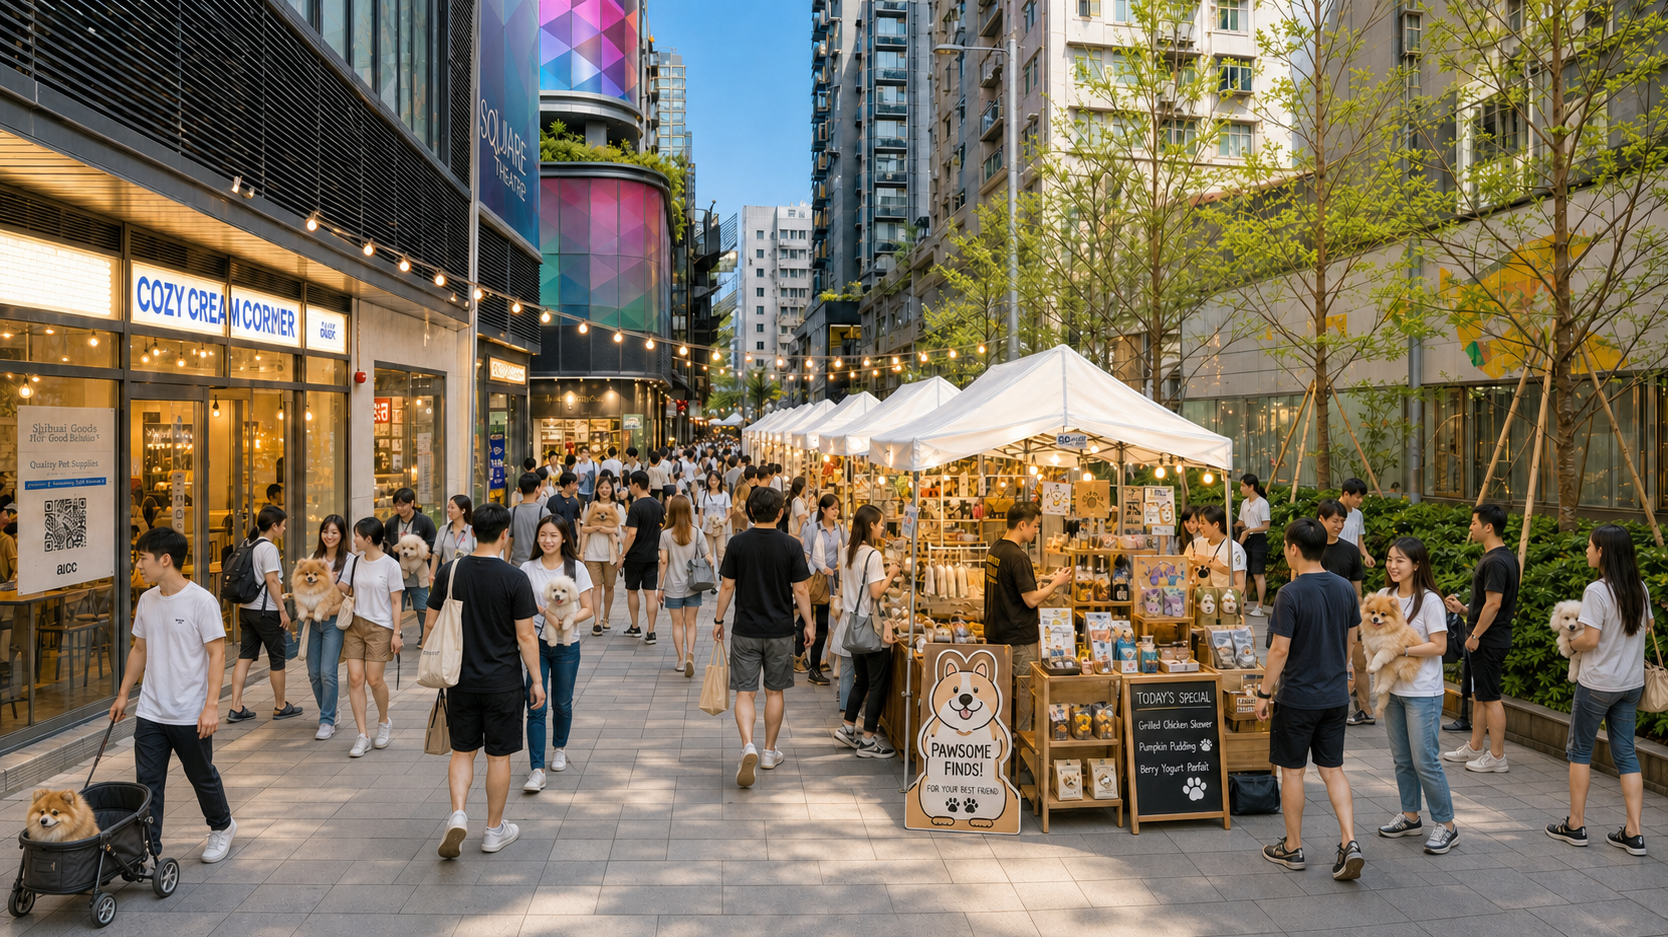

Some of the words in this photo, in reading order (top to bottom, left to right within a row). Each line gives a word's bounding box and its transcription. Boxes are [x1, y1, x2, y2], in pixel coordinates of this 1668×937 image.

[480, 98, 527, 176] SQUARE
[494, 155, 526, 202] THEATRE
[137, 276, 185, 317] COZY
[188, 287, 240, 328] CREAM
[71, 424, 98, 433] Goods
[48, 434, 68, 442] Good
[1136, 692, 1175, 704] TODAY'S
[1179, 691, 1211, 704] SPECIAL
[1138, 720, 1161, 730] Grilled
[931, 742, 992, 759] PAWSOME
[1139, 742, 1167, 754] Pumpkin
[1170, 741, 1196, 753] Pudding
[944, 761, 983, 777] FINDS!
[1140, 765, 1159, 776] Berry
[1161, 764, 1184, 776] Yogurt
[1187, 762, 1210, 772] Parfait
[927, 784, 939, 793] FOR
[960, 786, 975, 794] BEST
[977, 787, 999, 795] FRIEND
